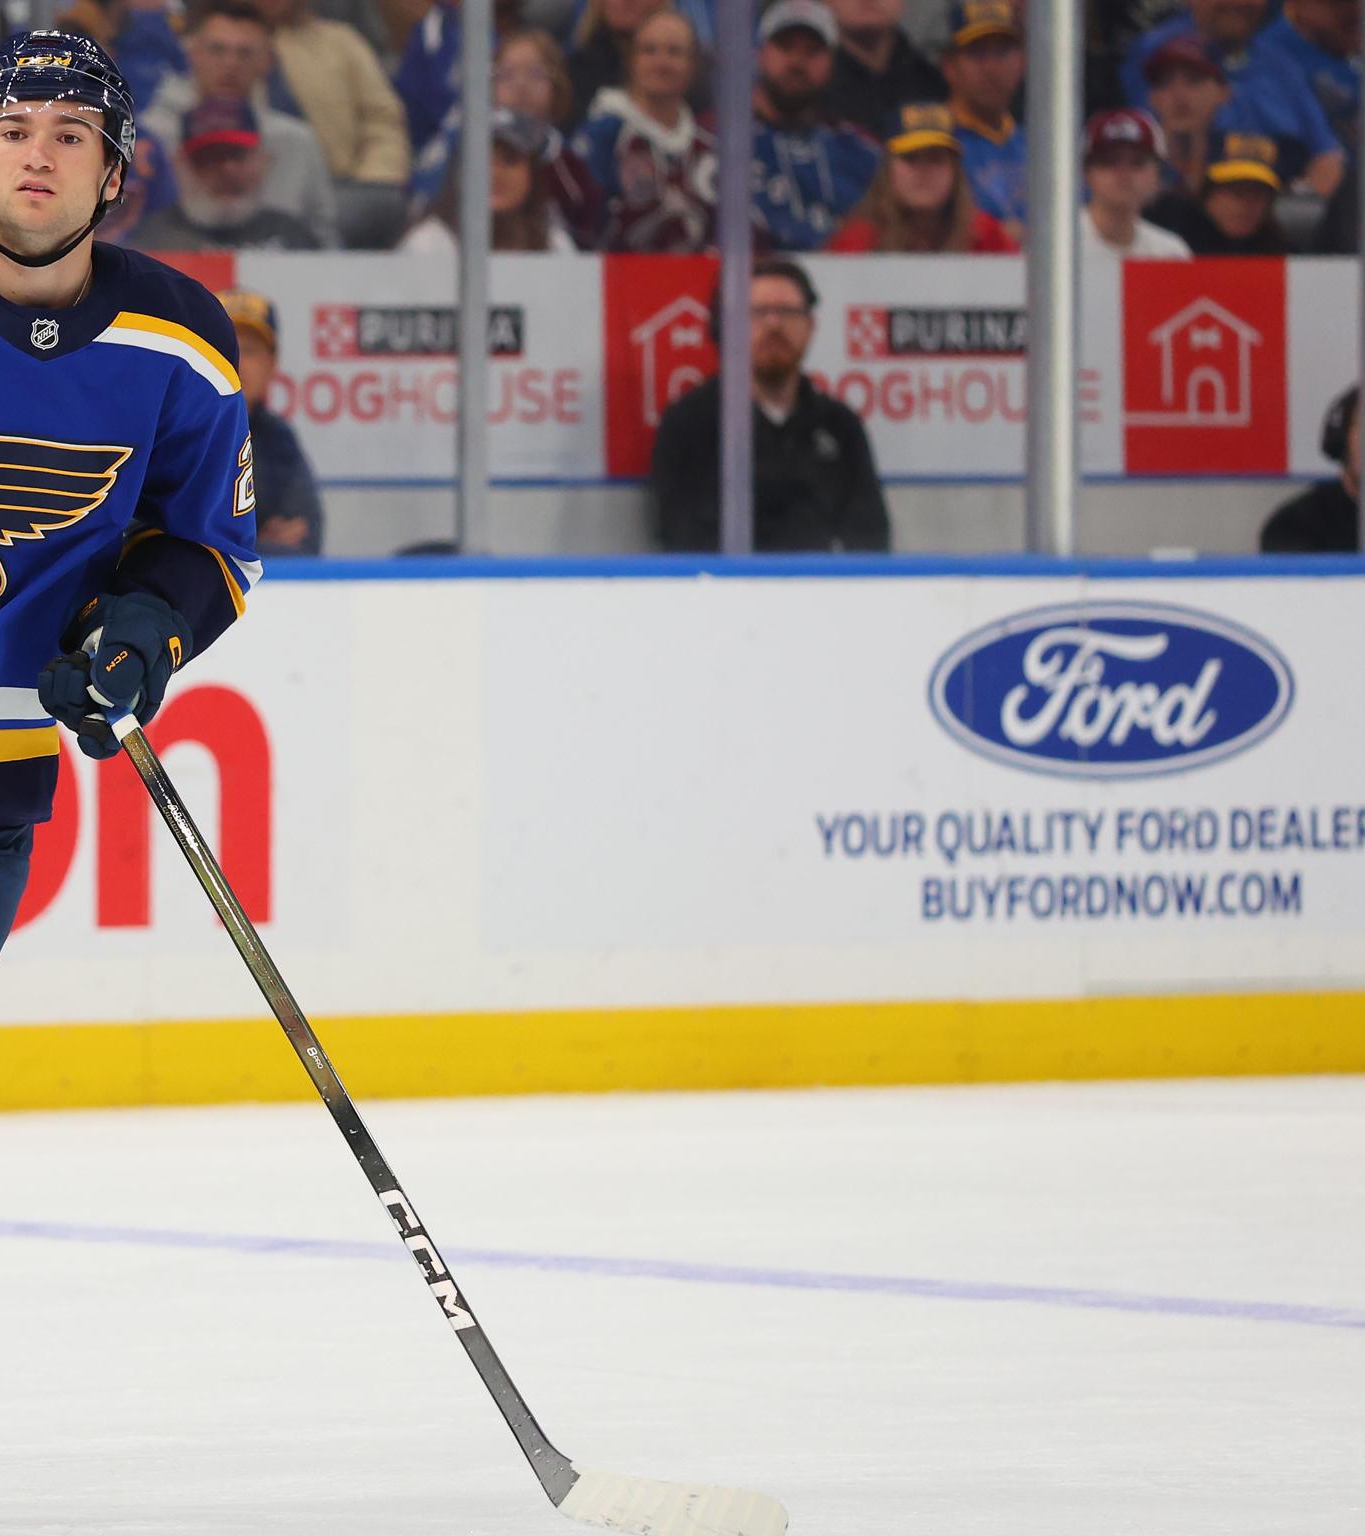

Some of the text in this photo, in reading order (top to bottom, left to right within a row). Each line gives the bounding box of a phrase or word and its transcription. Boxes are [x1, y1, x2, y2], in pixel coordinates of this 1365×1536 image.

[37, 327, 54, 343] NHL
[361, 313, 515, 349] PURIA
[105, 650, 129, 673] CCM
[1000, 626, 1223, 746] Ford
[815, 813, 925, 856] YOUR
[936, 809, 1104, 863] QUALITY
[1117, 809, 1219, 854] FORD
[922, 873, 1302, 920] BUYFORDNOW.COM
[378, 1189, 477, 1331] CCM
